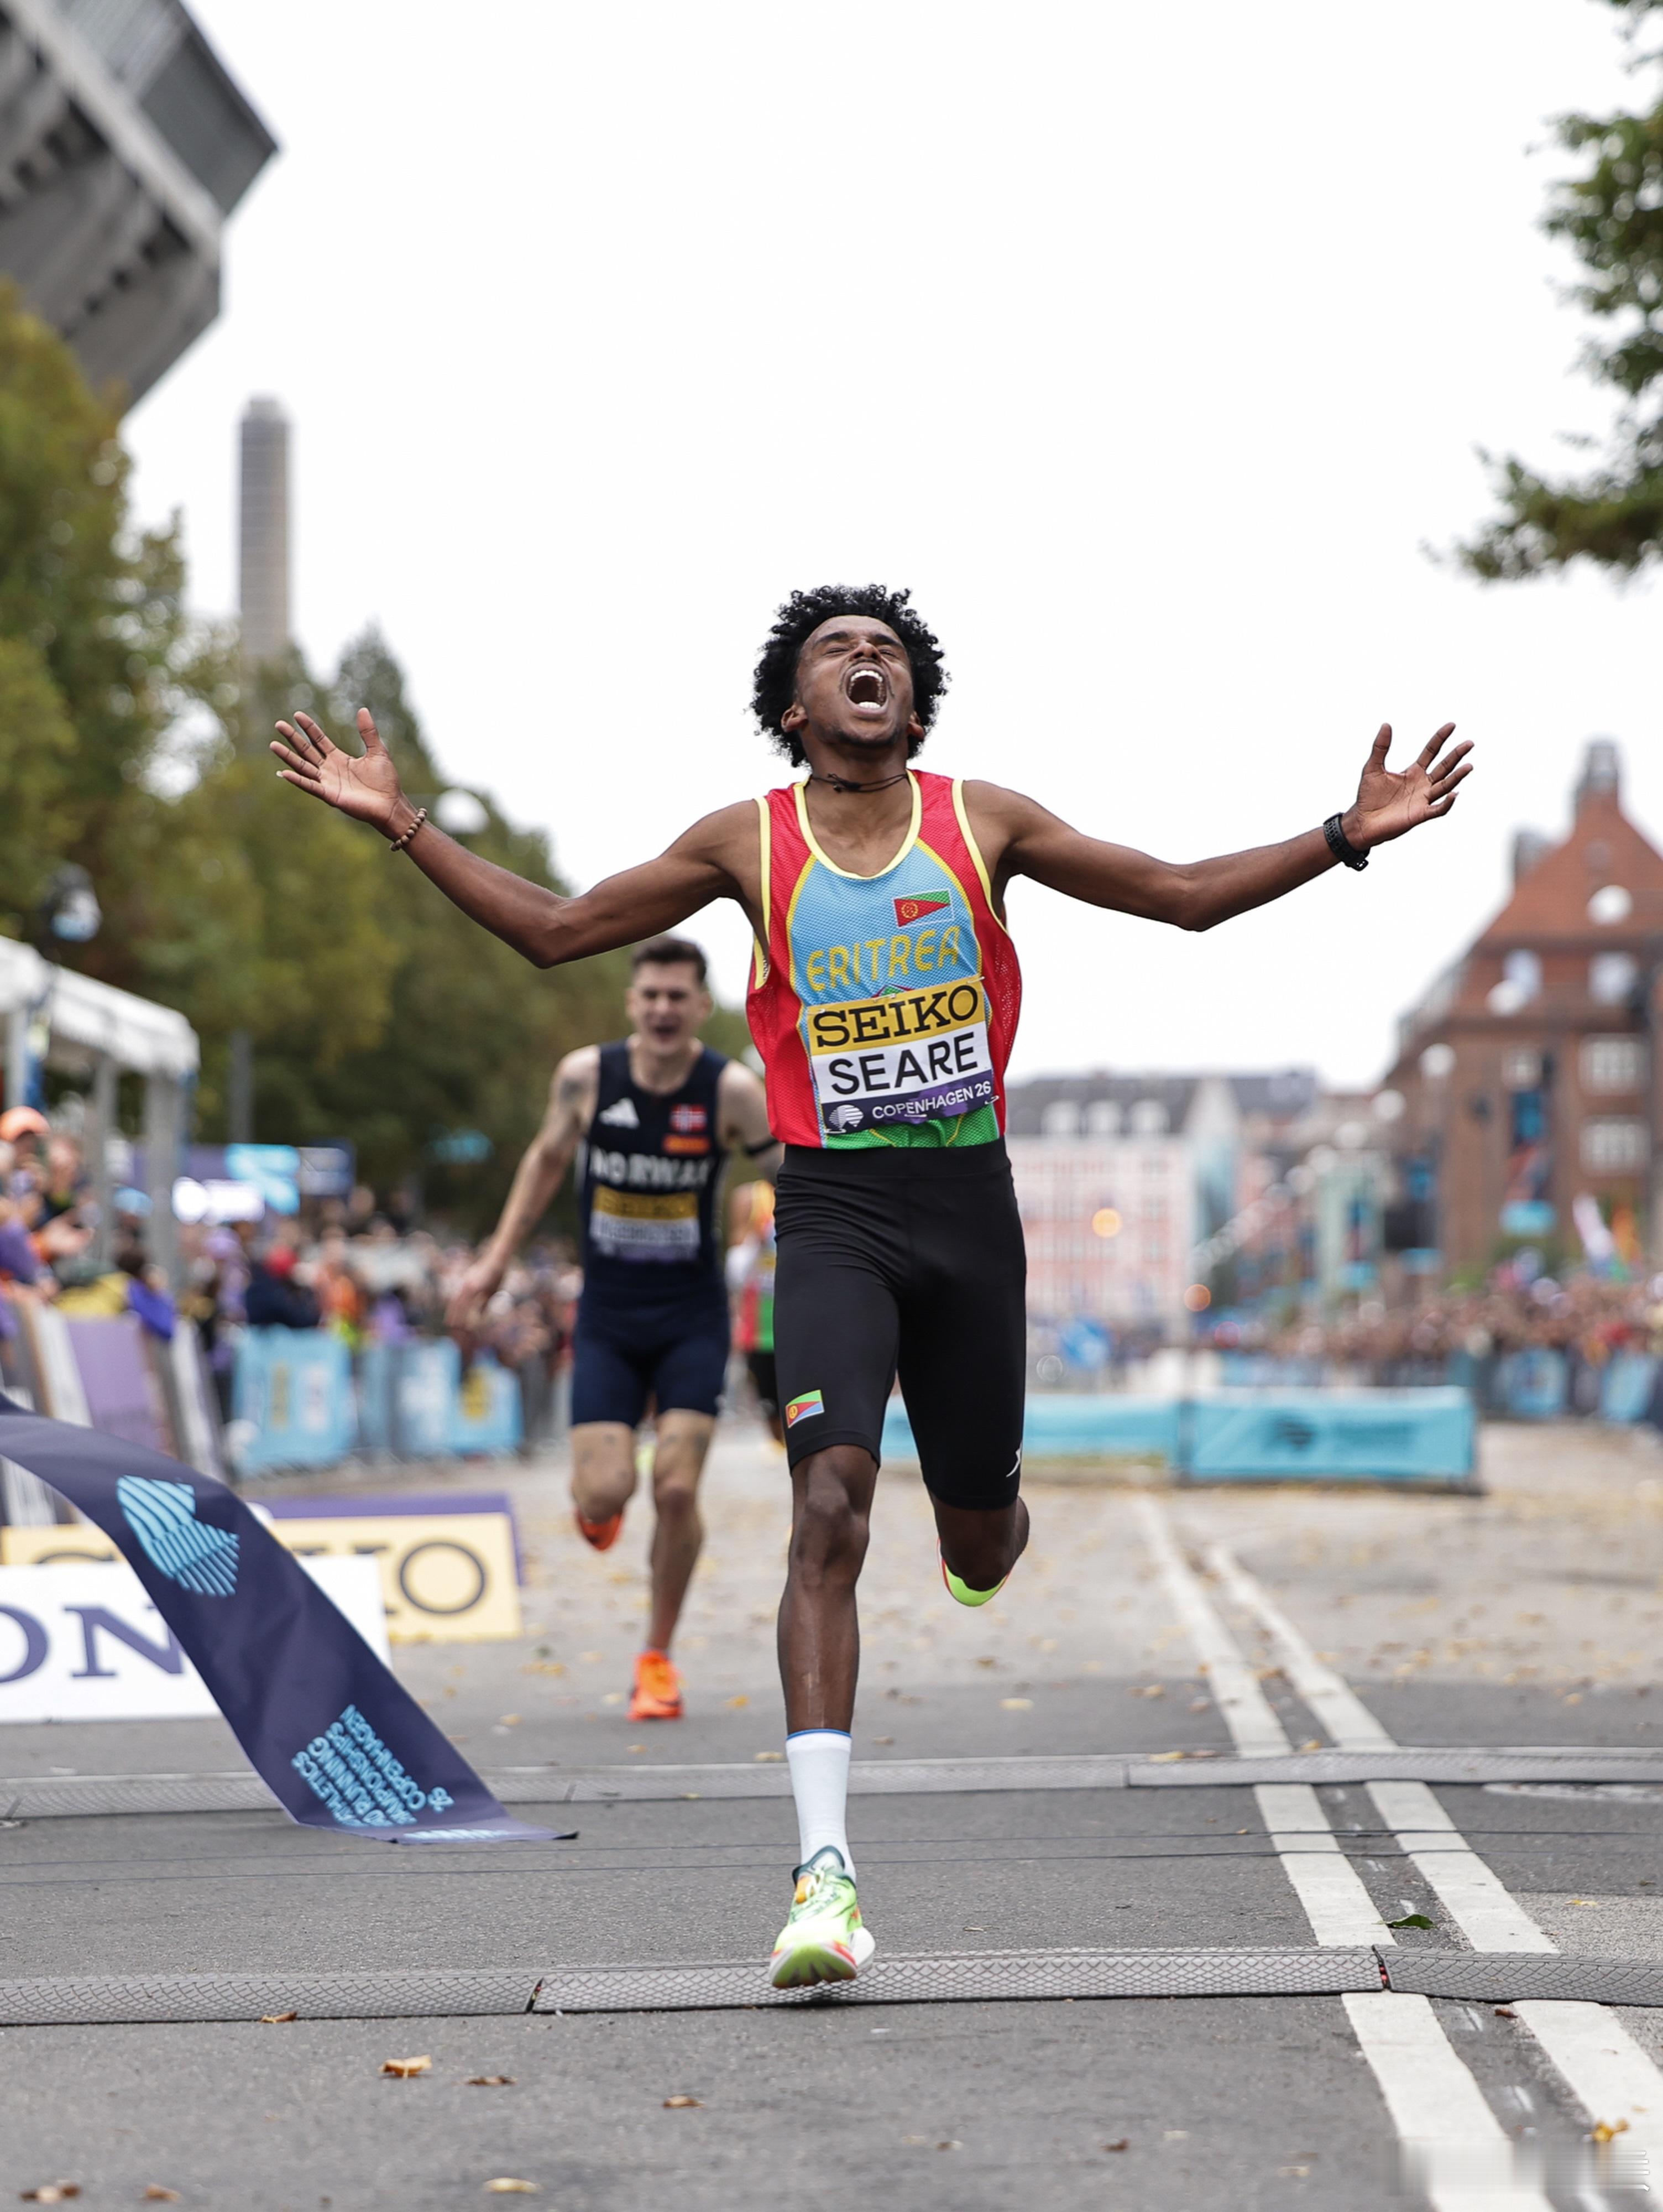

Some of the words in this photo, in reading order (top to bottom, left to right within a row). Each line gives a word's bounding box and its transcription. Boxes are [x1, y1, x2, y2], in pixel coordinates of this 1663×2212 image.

[807, 925, 961, 992] ERITREA
[813, 984, 979, 1047] SEIKO
[829, 1031, 978, 1095] SEARE
[872, 1086, 974, 1119] COPENHAGEN
[975, 1081, 992, 1098] 26
[339, 1703, 426, 1811] COPENHAGEN
